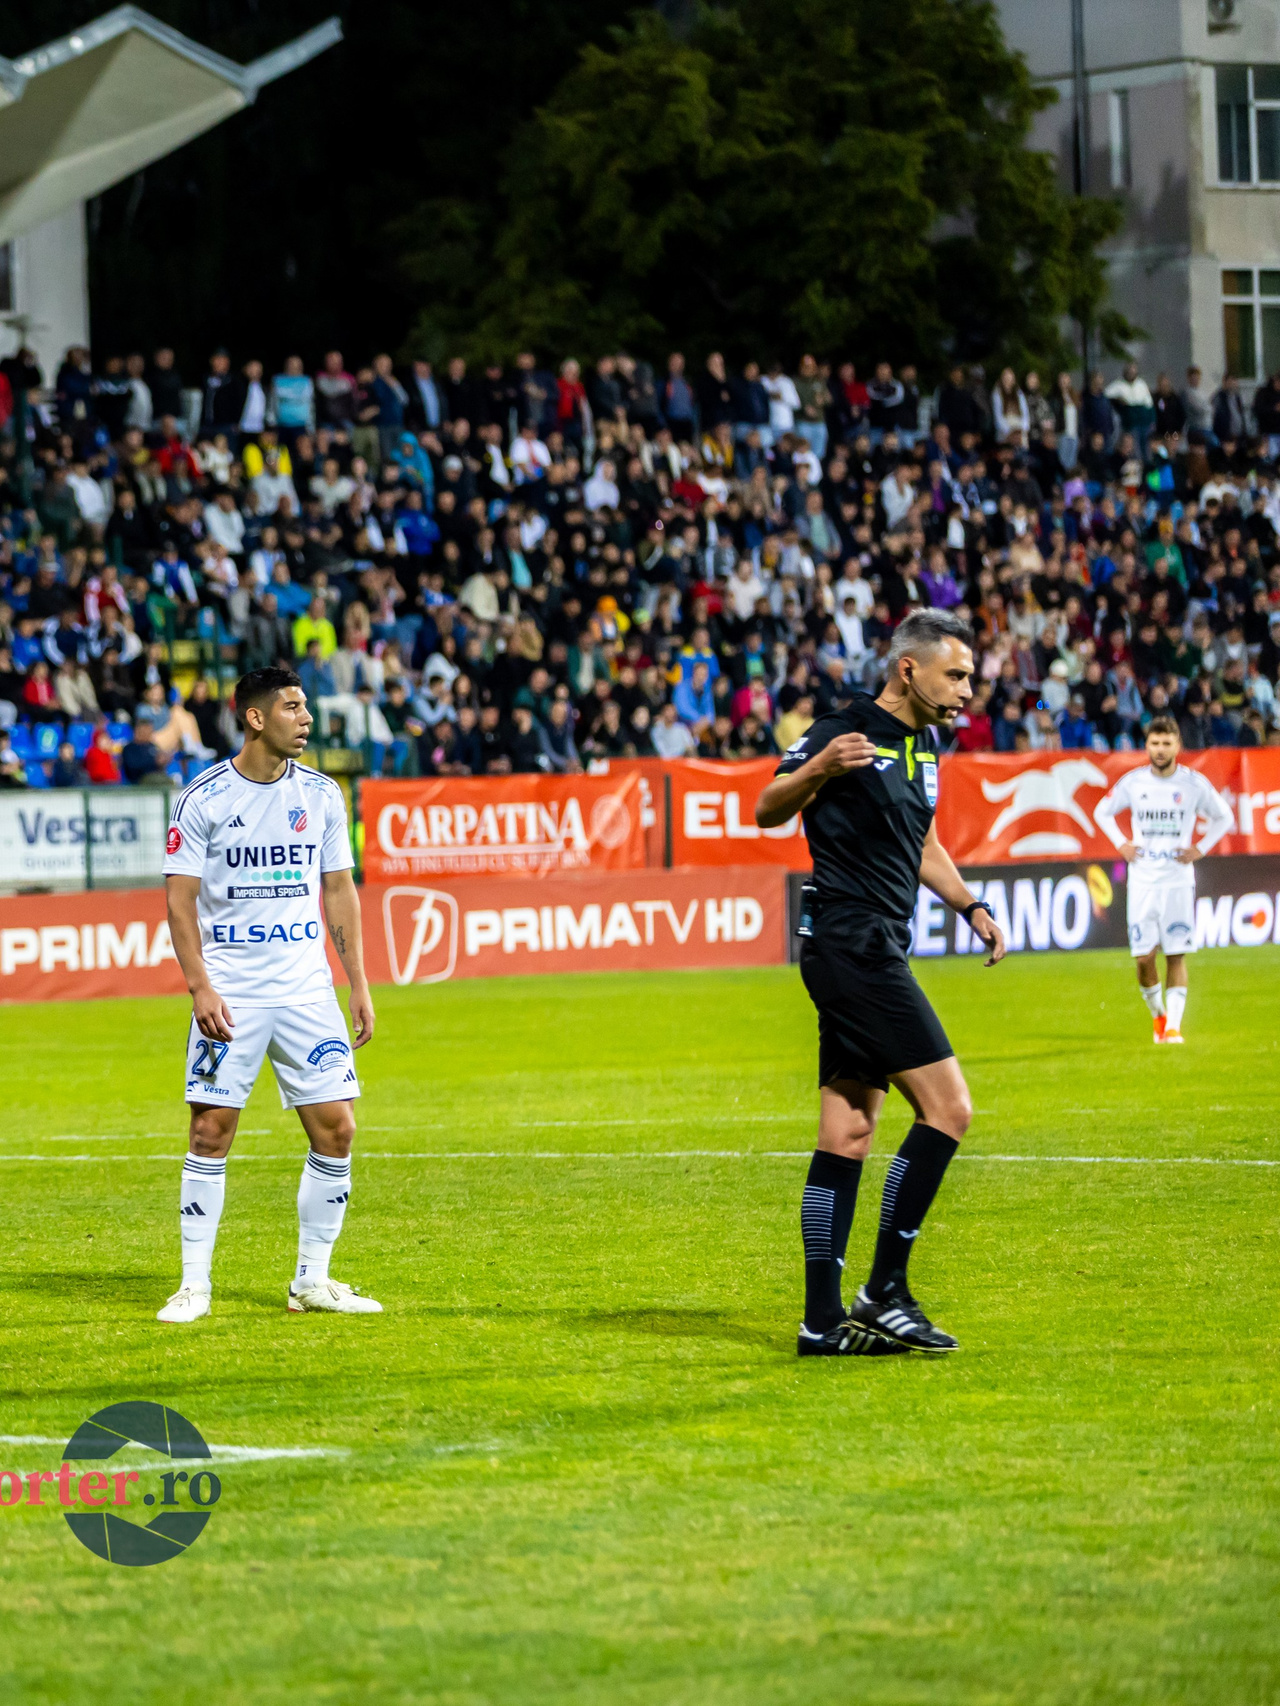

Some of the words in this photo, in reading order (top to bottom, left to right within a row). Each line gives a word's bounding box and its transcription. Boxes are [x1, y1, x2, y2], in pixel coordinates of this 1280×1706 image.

[18, 808, 138, 844] Vestra
[377, 797, 590, 857] CARPATINA
[684, 791, 807, 839] EL
[226, 845, 317, 868] UNIBET
[213, 921, 318, 943] ELSACO
[704, 896, 765, 943] HD
[908, 875, 1092, 957] ETANO
[0, 918, 180, 976] PRIMA
[191, 1039, 230, 1078] 27
[203, 1084, 230, 1096] Vestra
